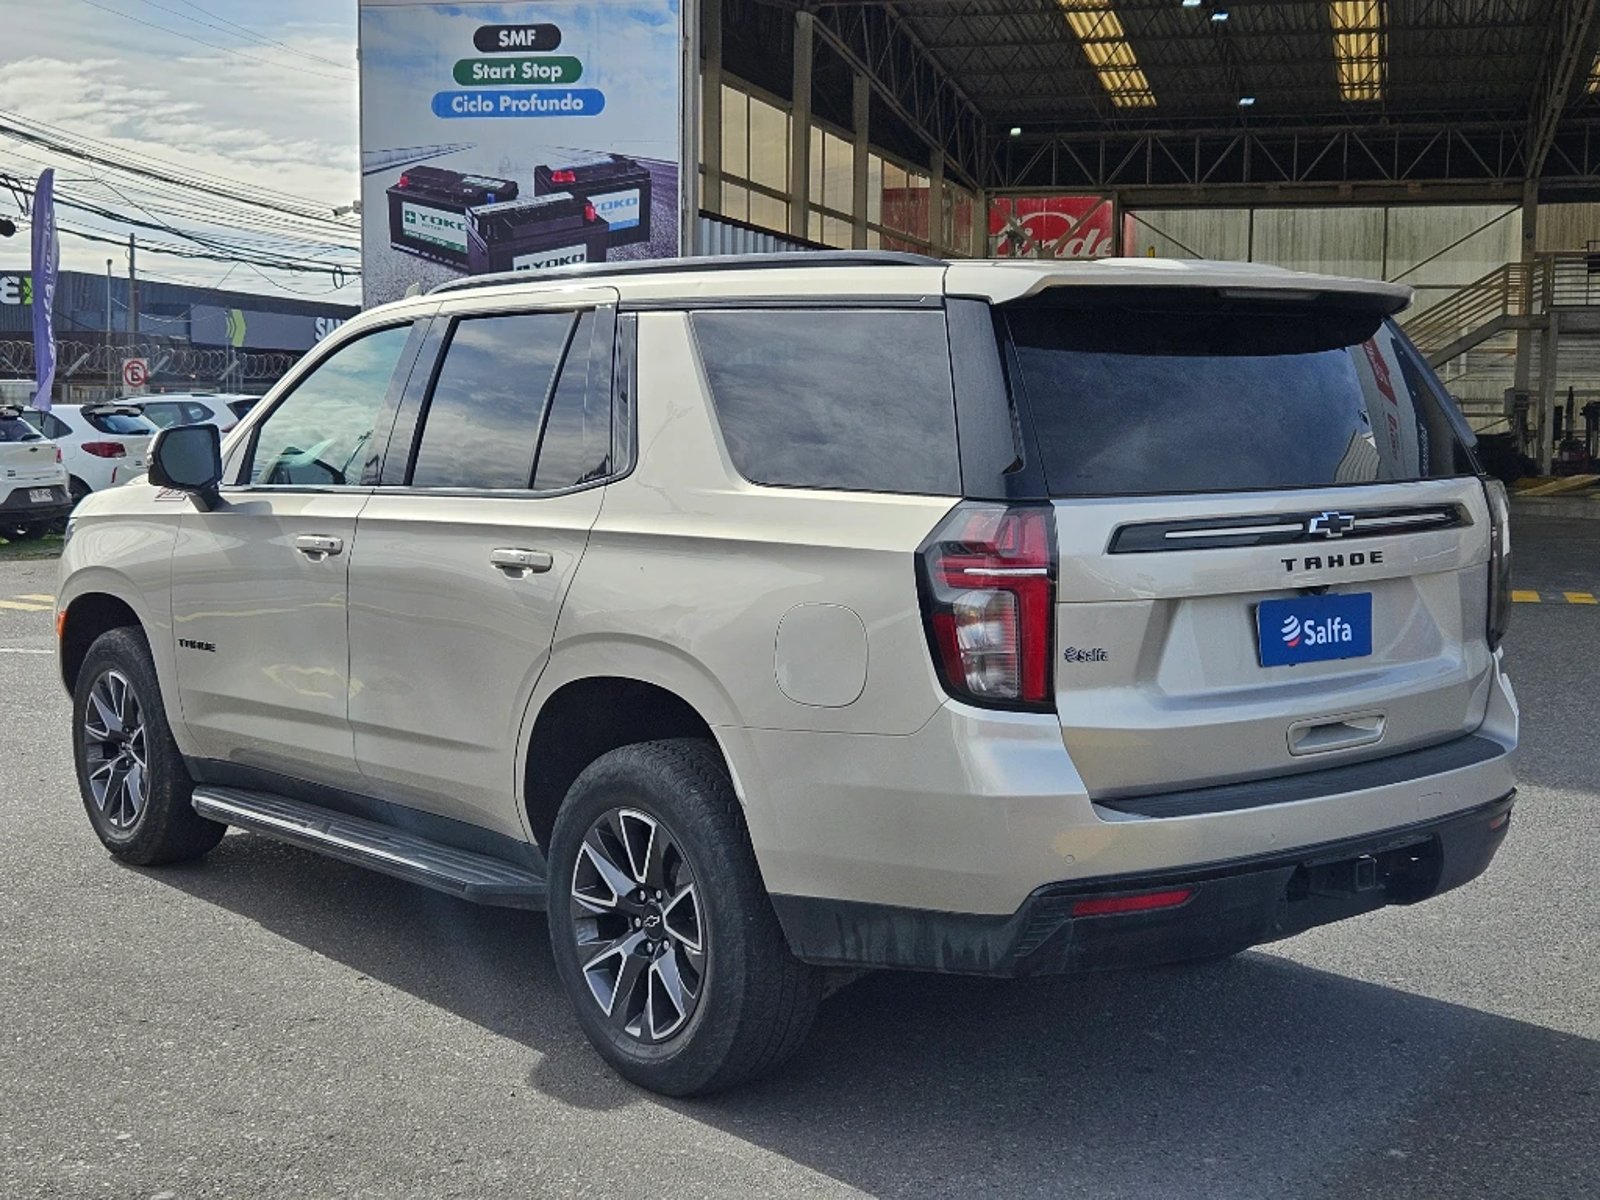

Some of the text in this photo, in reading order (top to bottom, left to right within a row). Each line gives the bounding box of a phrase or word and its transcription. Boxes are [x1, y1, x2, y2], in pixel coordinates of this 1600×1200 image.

[498, 29, 536, 47] SMF
[472, 62, 563, 82] Start Stop
[451, 93, 584, 113] Ciclo Profundo
[596, 197, 638, 211] OKO
[1280, 550, 1384, 572] TAHOE
[1303, 616, 1353, 646] Salfa
